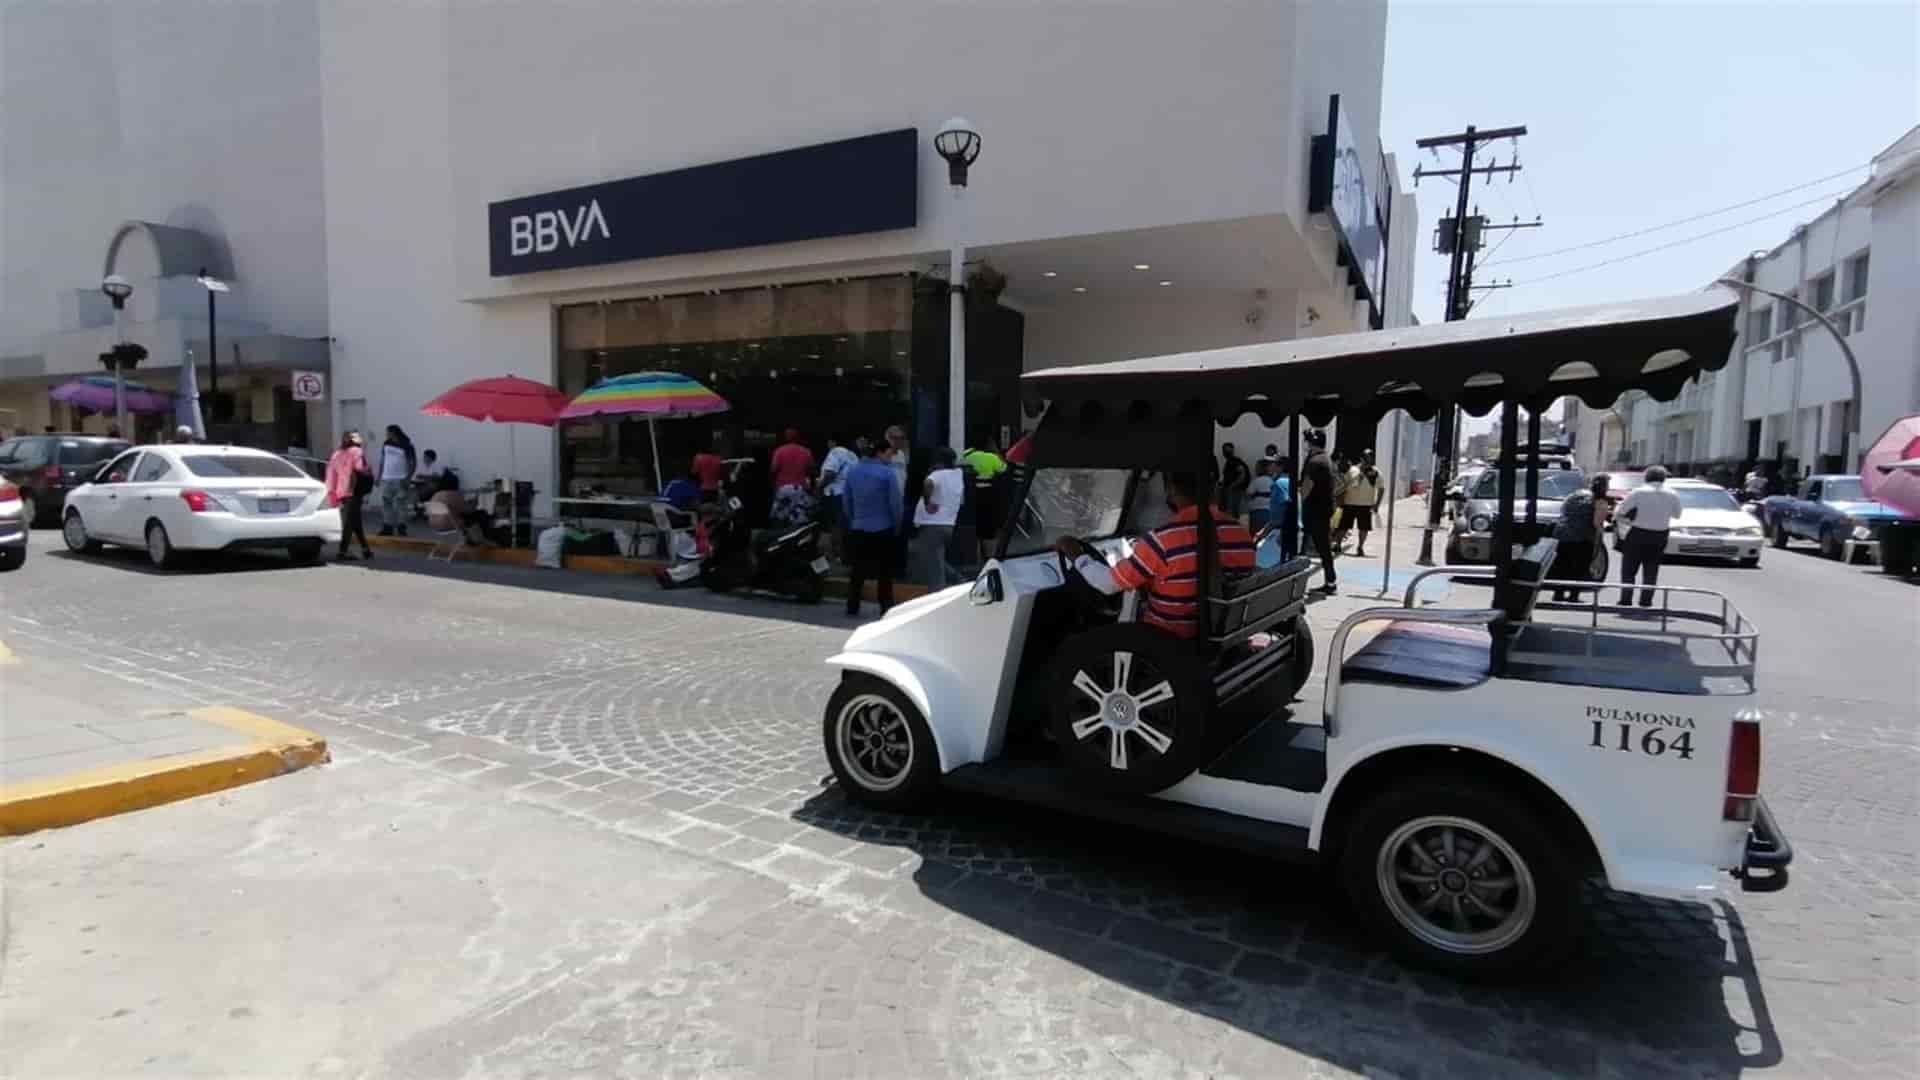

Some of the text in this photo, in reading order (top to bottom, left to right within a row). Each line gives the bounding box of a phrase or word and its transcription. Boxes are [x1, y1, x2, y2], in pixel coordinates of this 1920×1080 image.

[511, 198, 610, 256] BBVA
[1585, 705, 1696, 729] PULMONIA
[1588, 720, 1694, 760] 1164
